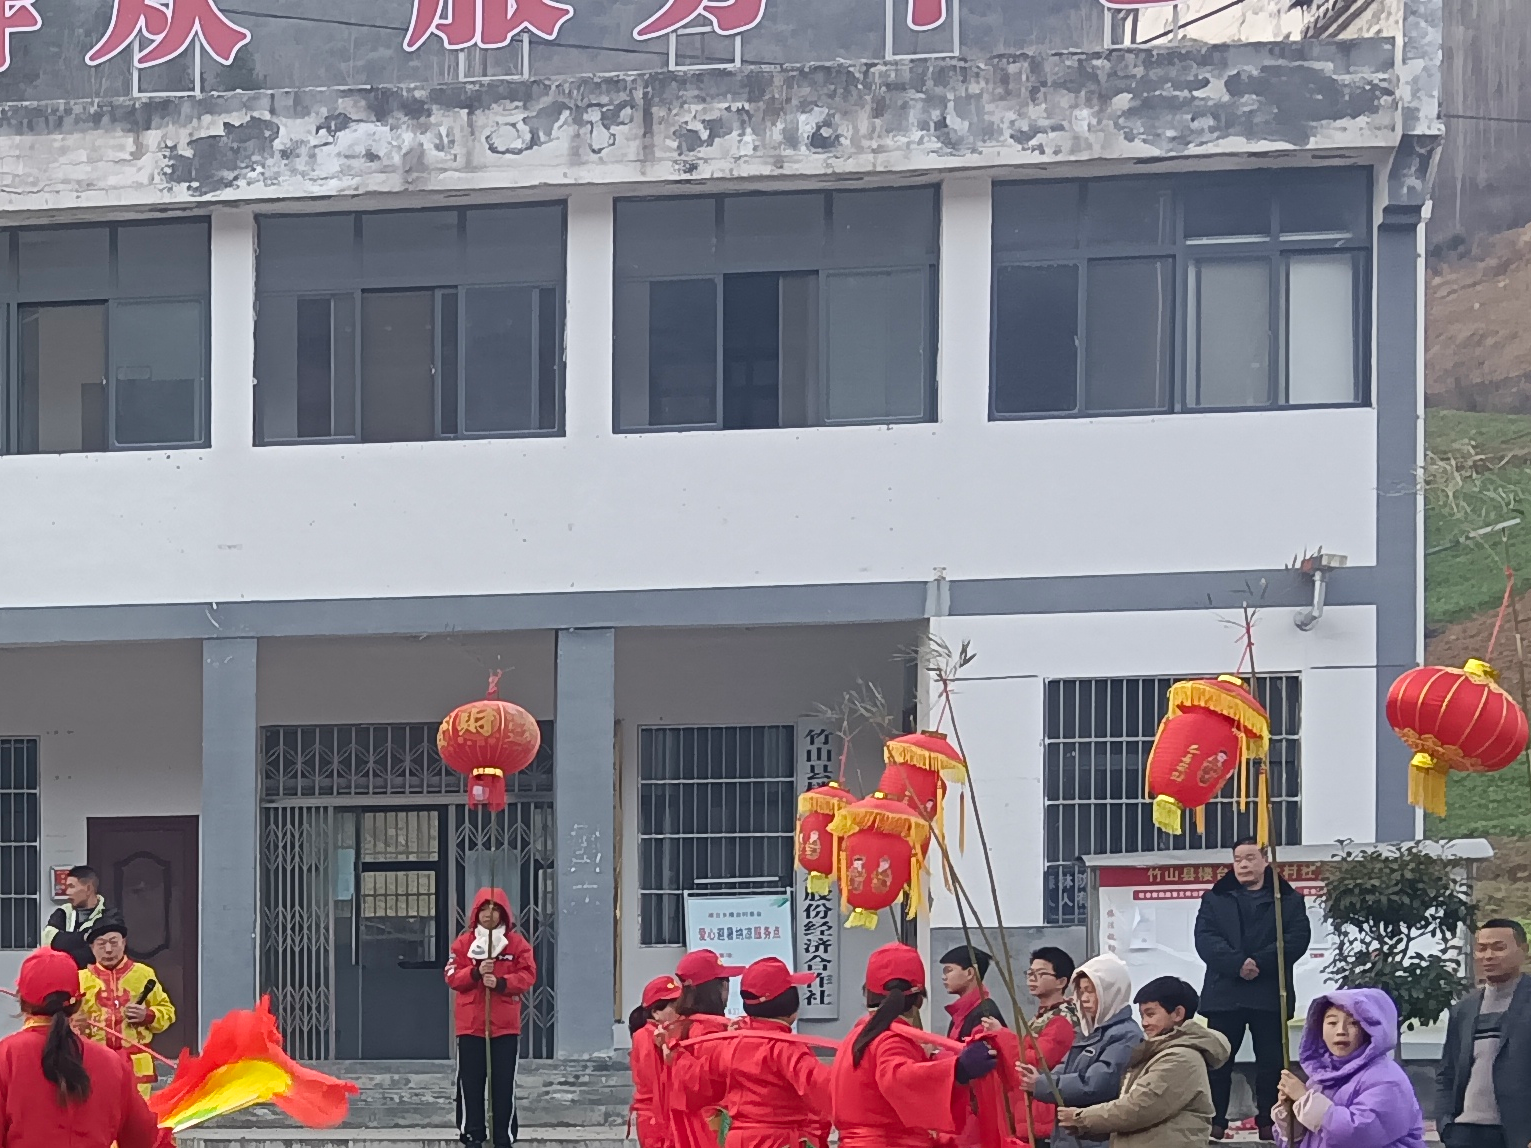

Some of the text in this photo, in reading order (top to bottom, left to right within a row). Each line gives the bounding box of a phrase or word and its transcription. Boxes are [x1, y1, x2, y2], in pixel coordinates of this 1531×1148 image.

[803, 728, 834, 1006] 竹山县股份经济合作社
